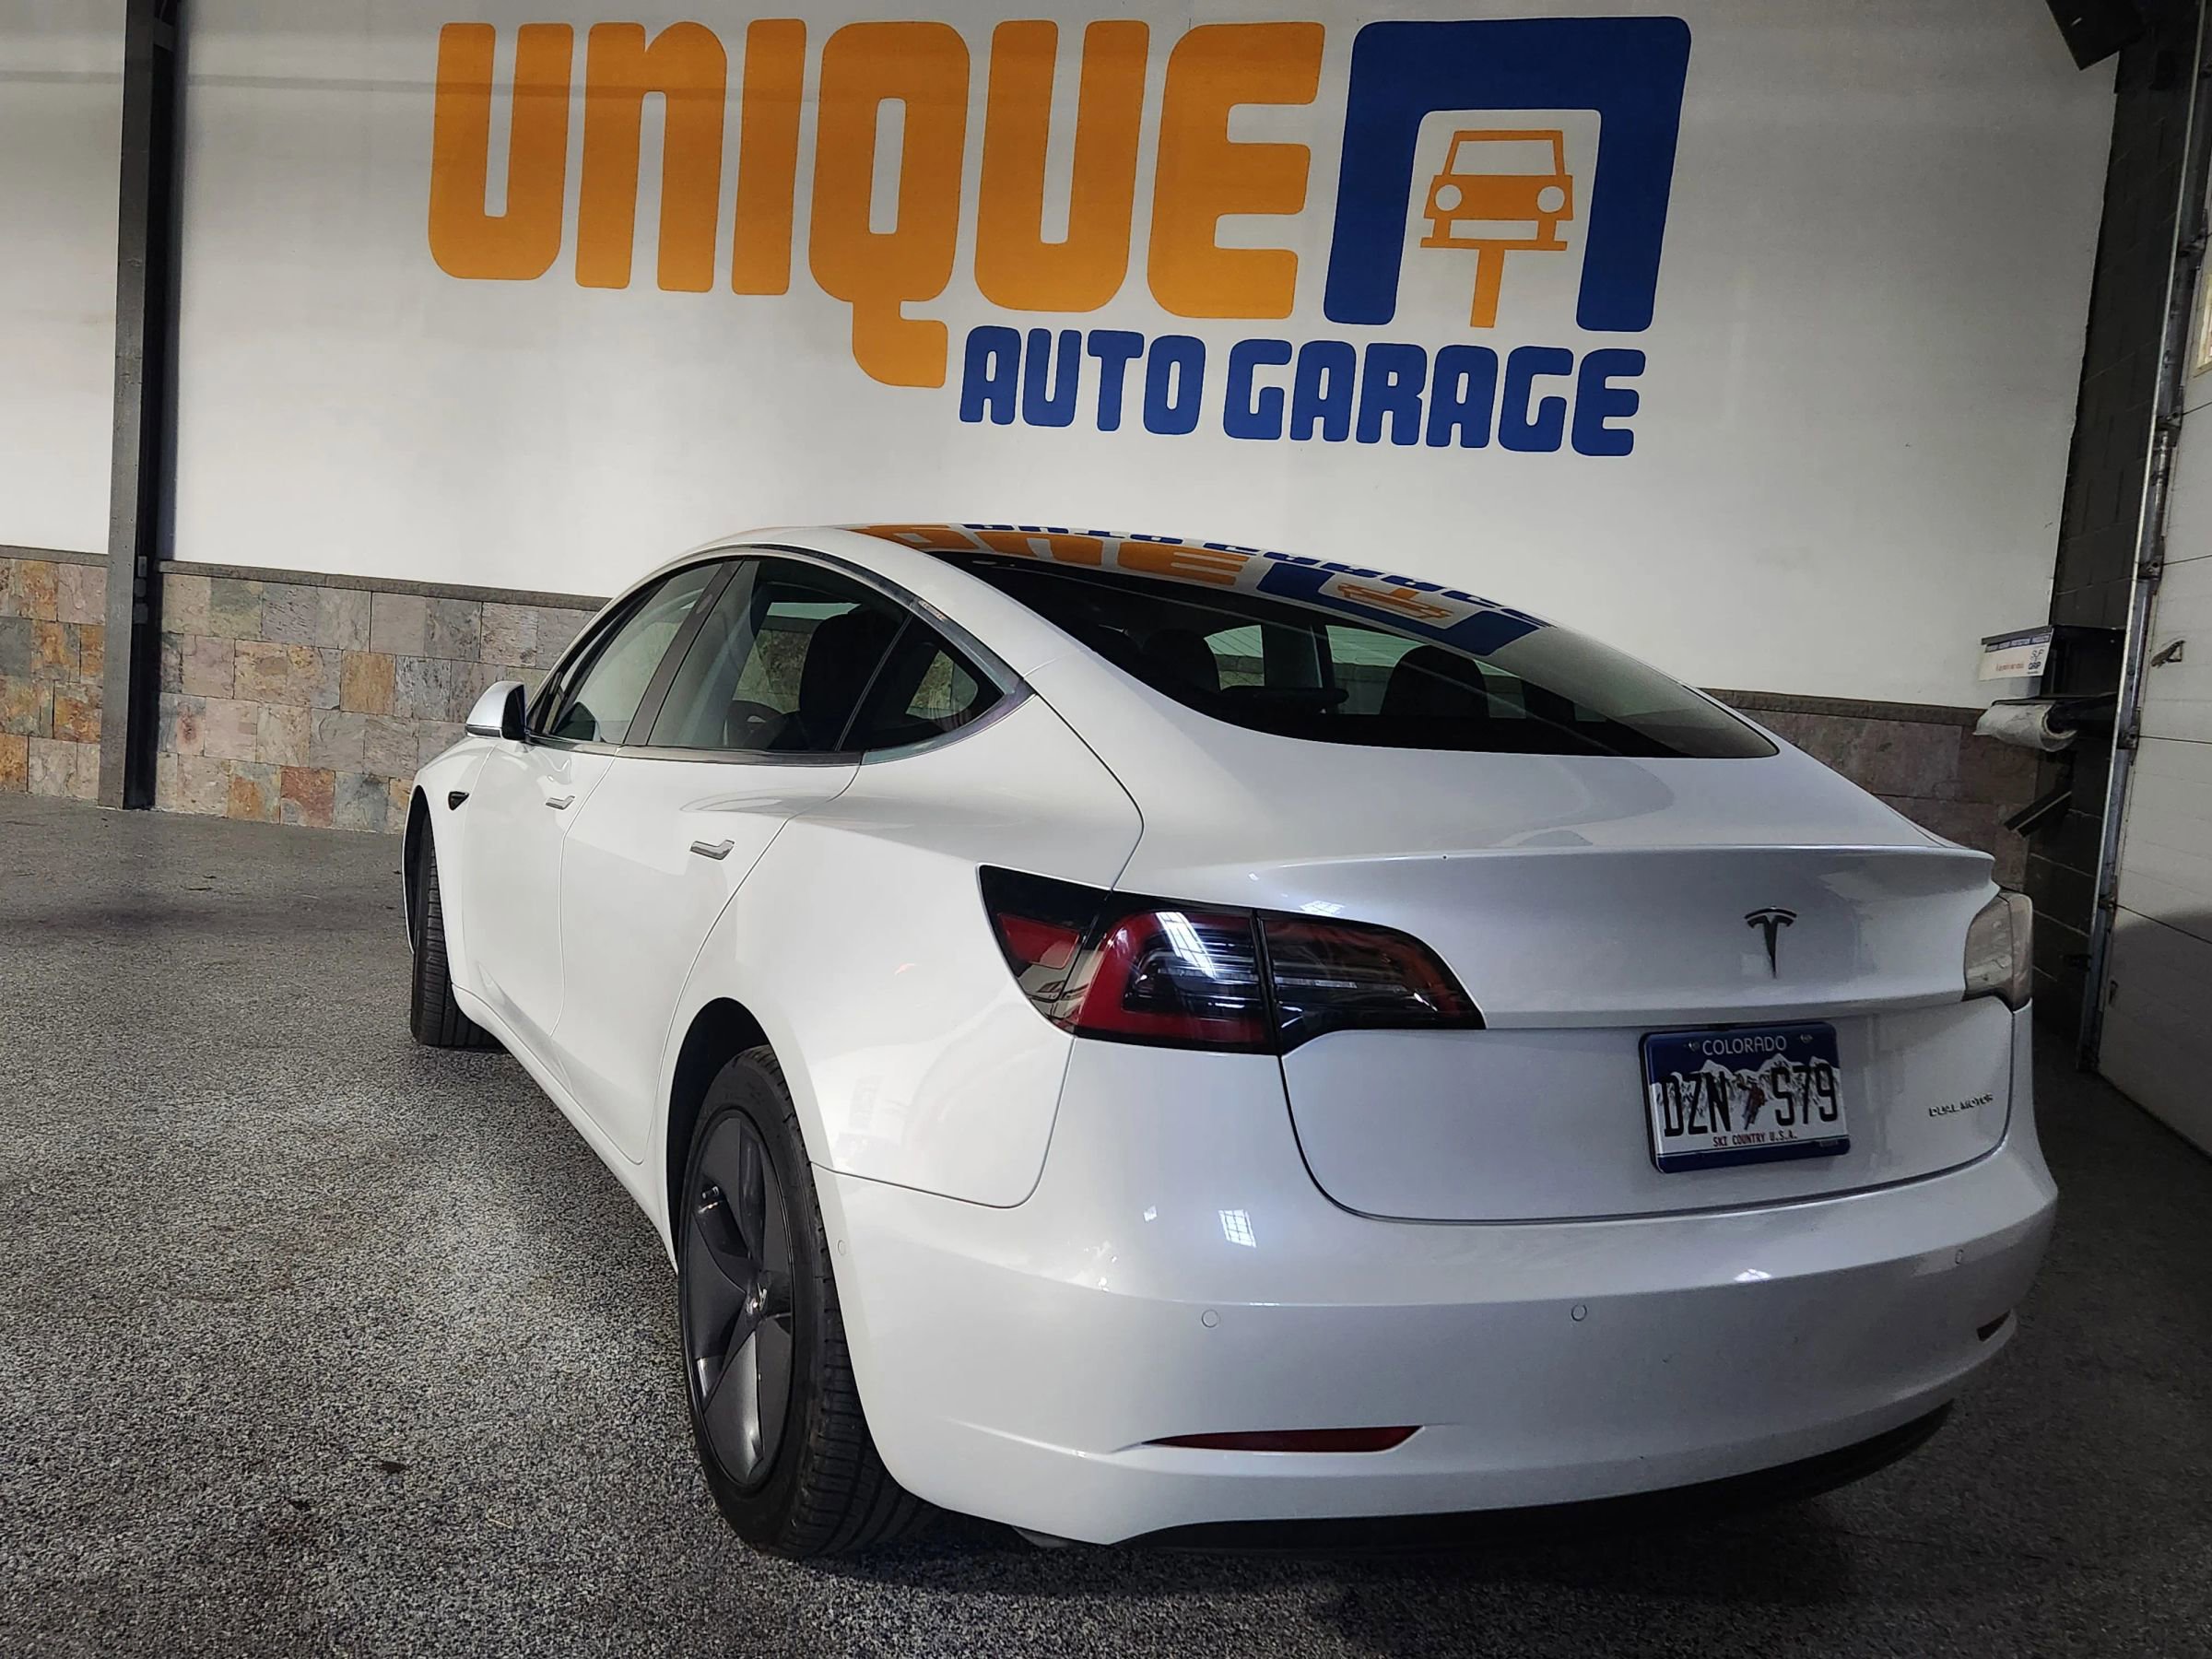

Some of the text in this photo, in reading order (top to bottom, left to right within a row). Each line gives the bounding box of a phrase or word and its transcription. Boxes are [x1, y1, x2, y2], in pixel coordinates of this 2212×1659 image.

[959, 326, 1645, 455] AUTO GARAGE
[1702, 1035, 1787, 1055] COLORADO
[1771, 1064, 1839, 1126] S79
[1712, 1136, 1728, 1147] SKI
[1732, 1133, 1765, 1146] COUNTRY
